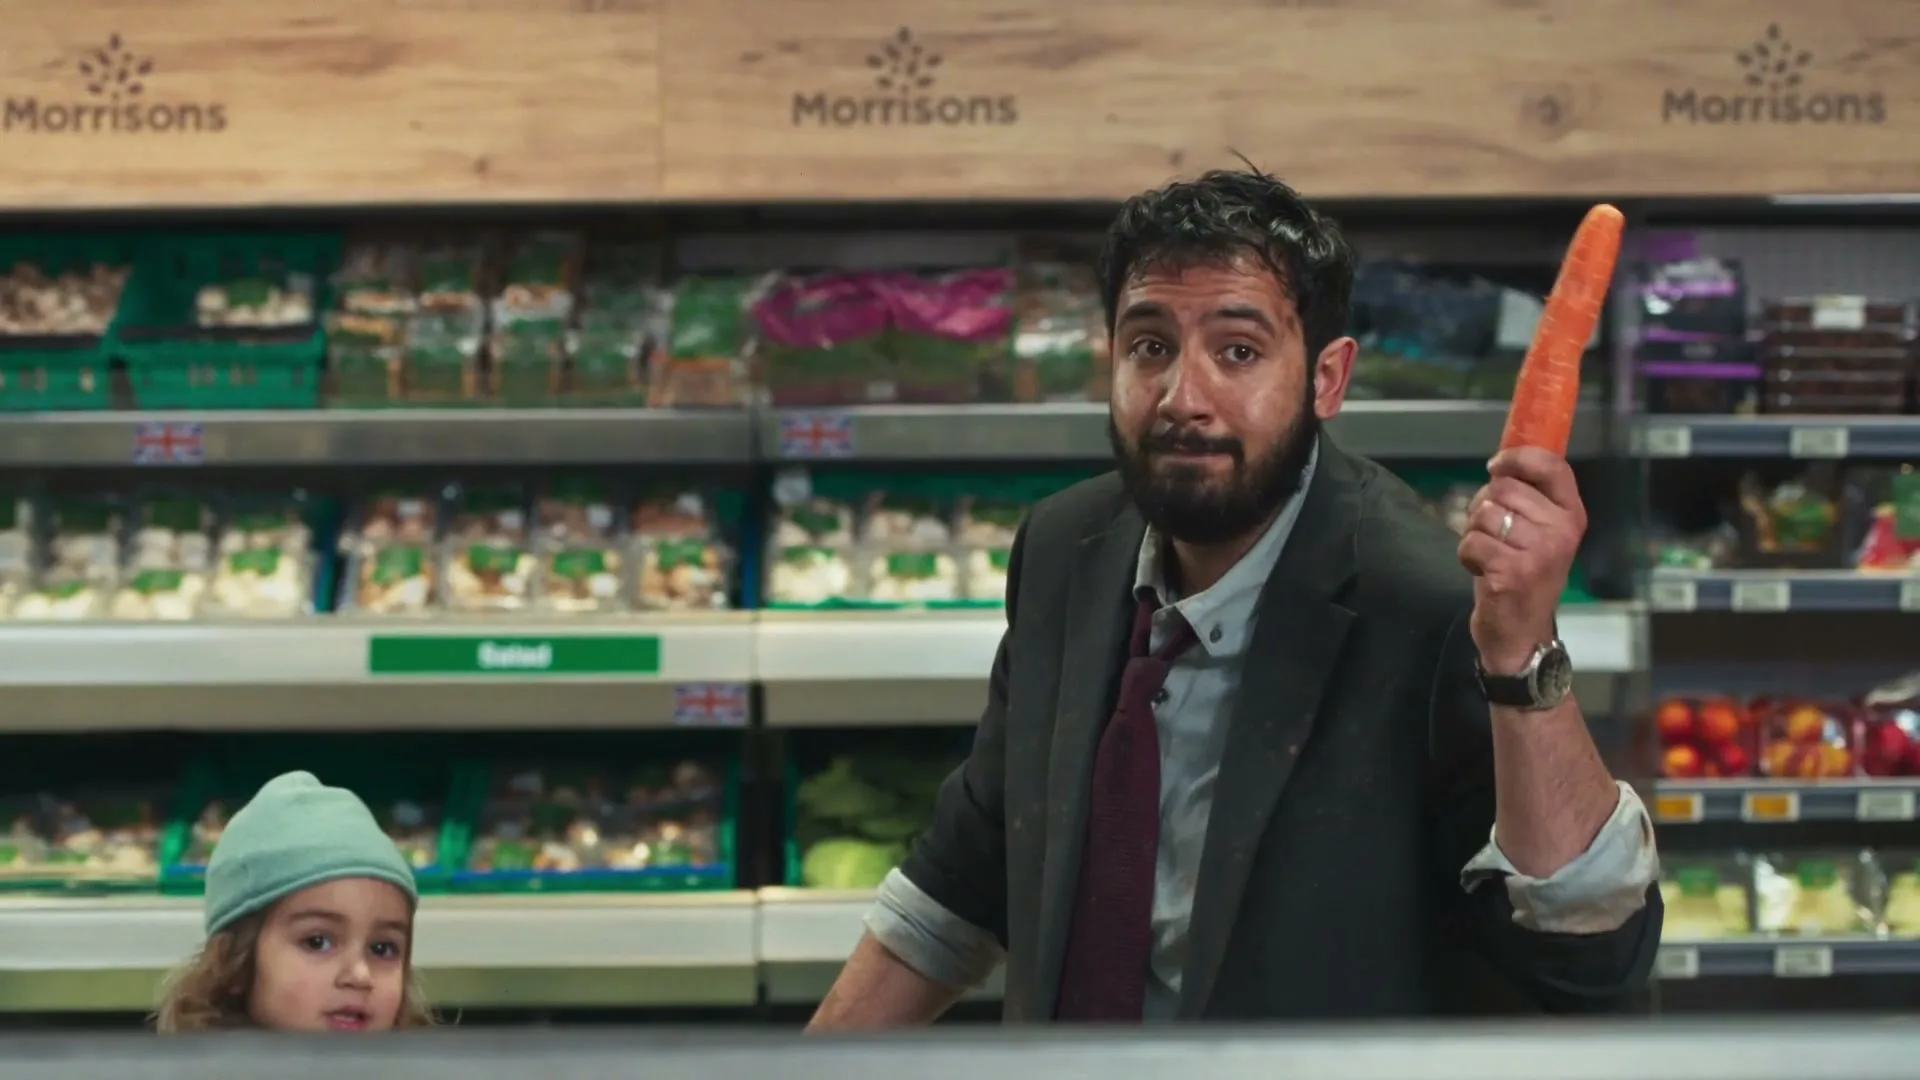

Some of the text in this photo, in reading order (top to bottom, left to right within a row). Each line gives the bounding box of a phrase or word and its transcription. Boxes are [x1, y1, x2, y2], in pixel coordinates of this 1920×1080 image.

[3, 95, 227, 132] Morrisons
[792, 91, 1018, 126] Morrisons
[1662, 89, 1887, 125] Morrisons
[479, 642, 551, 668] Salad
